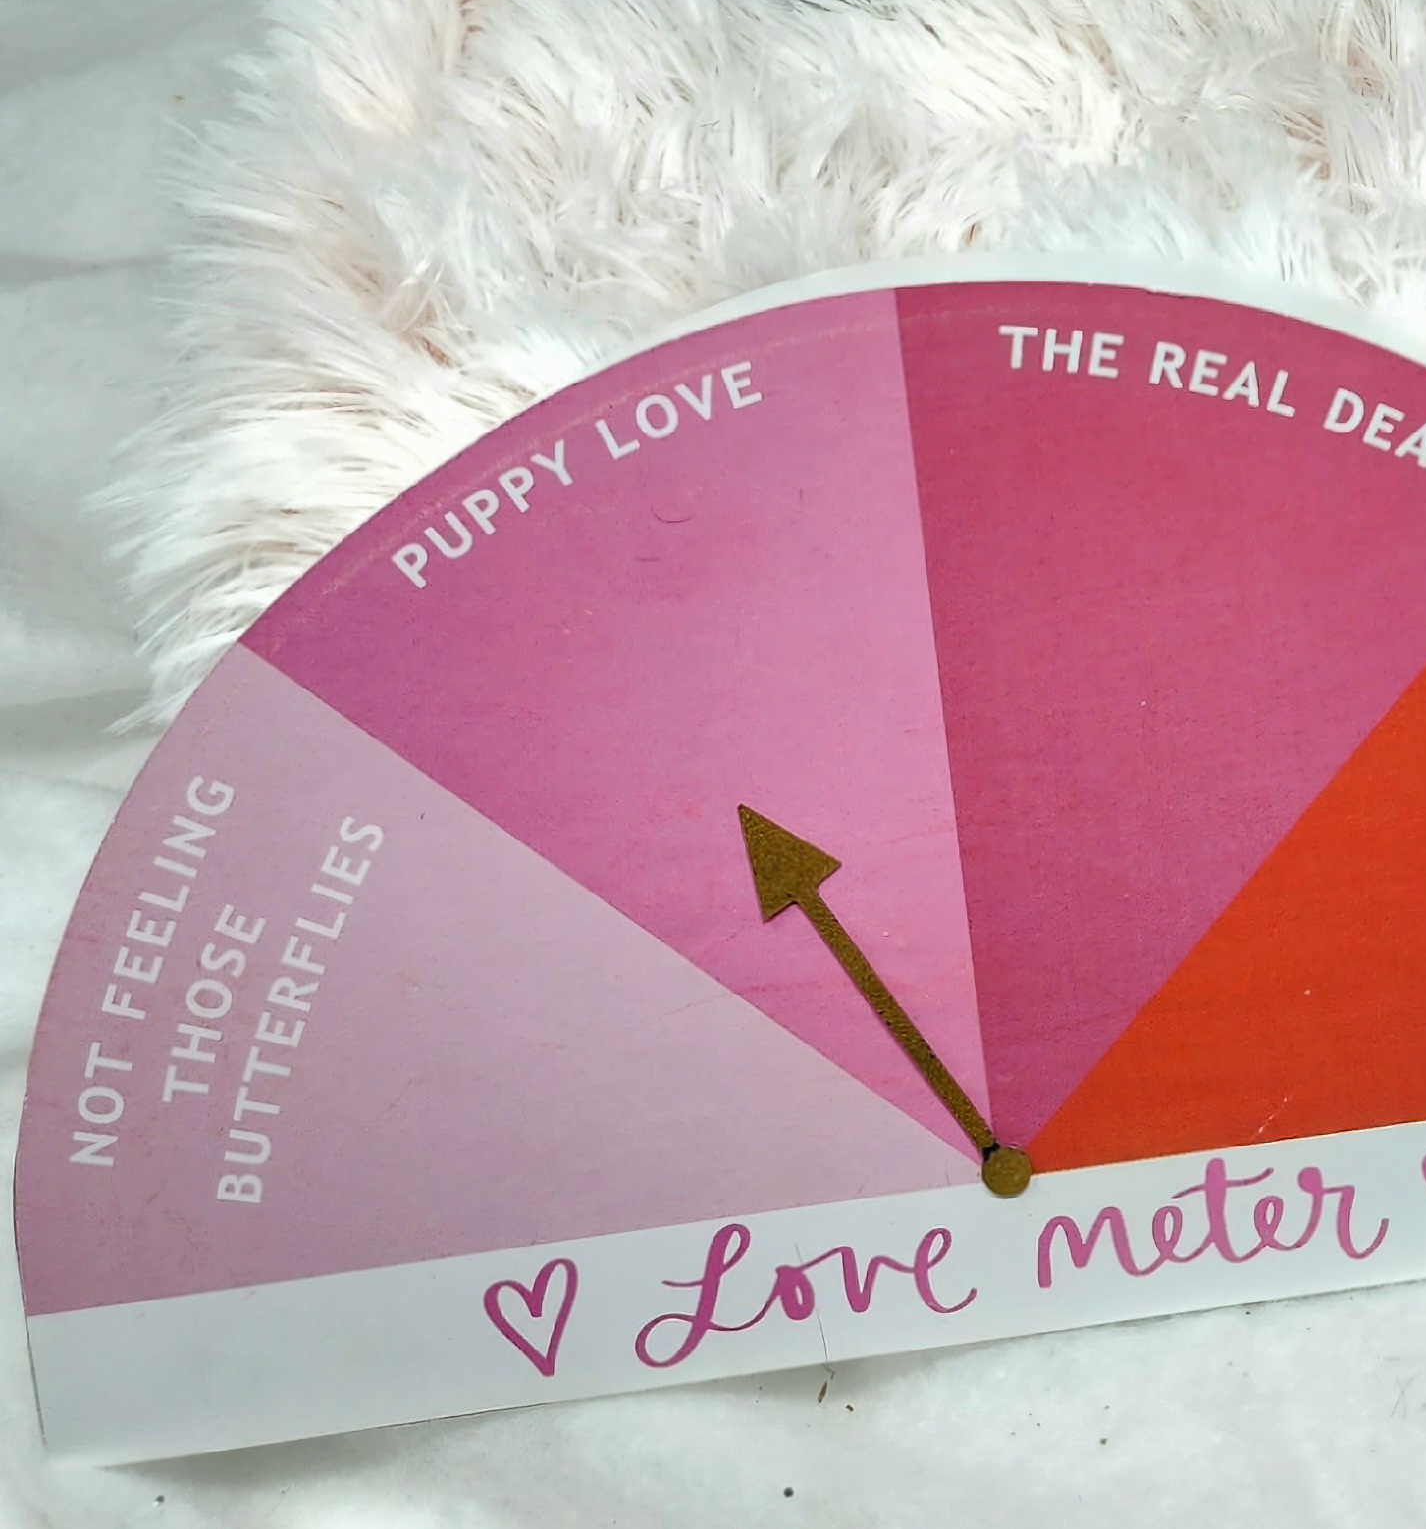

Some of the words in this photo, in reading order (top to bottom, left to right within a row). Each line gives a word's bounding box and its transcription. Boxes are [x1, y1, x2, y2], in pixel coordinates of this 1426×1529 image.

[1000, 325, 1120, 378] THE
[1149, 341, 1296, 417] REAL
[391, 440, 579, 589] PUPPY
[596, 361, 764, 460] LOVE
[101, 775, 235, 1020] FEELING
[162, 904, 264, 1102] THOSE
[217, 815, 385, 1203] BUTTERFLIES
[70, 1045, 133, 1168] NOT
[635, 1223, 977, 1367] Love
